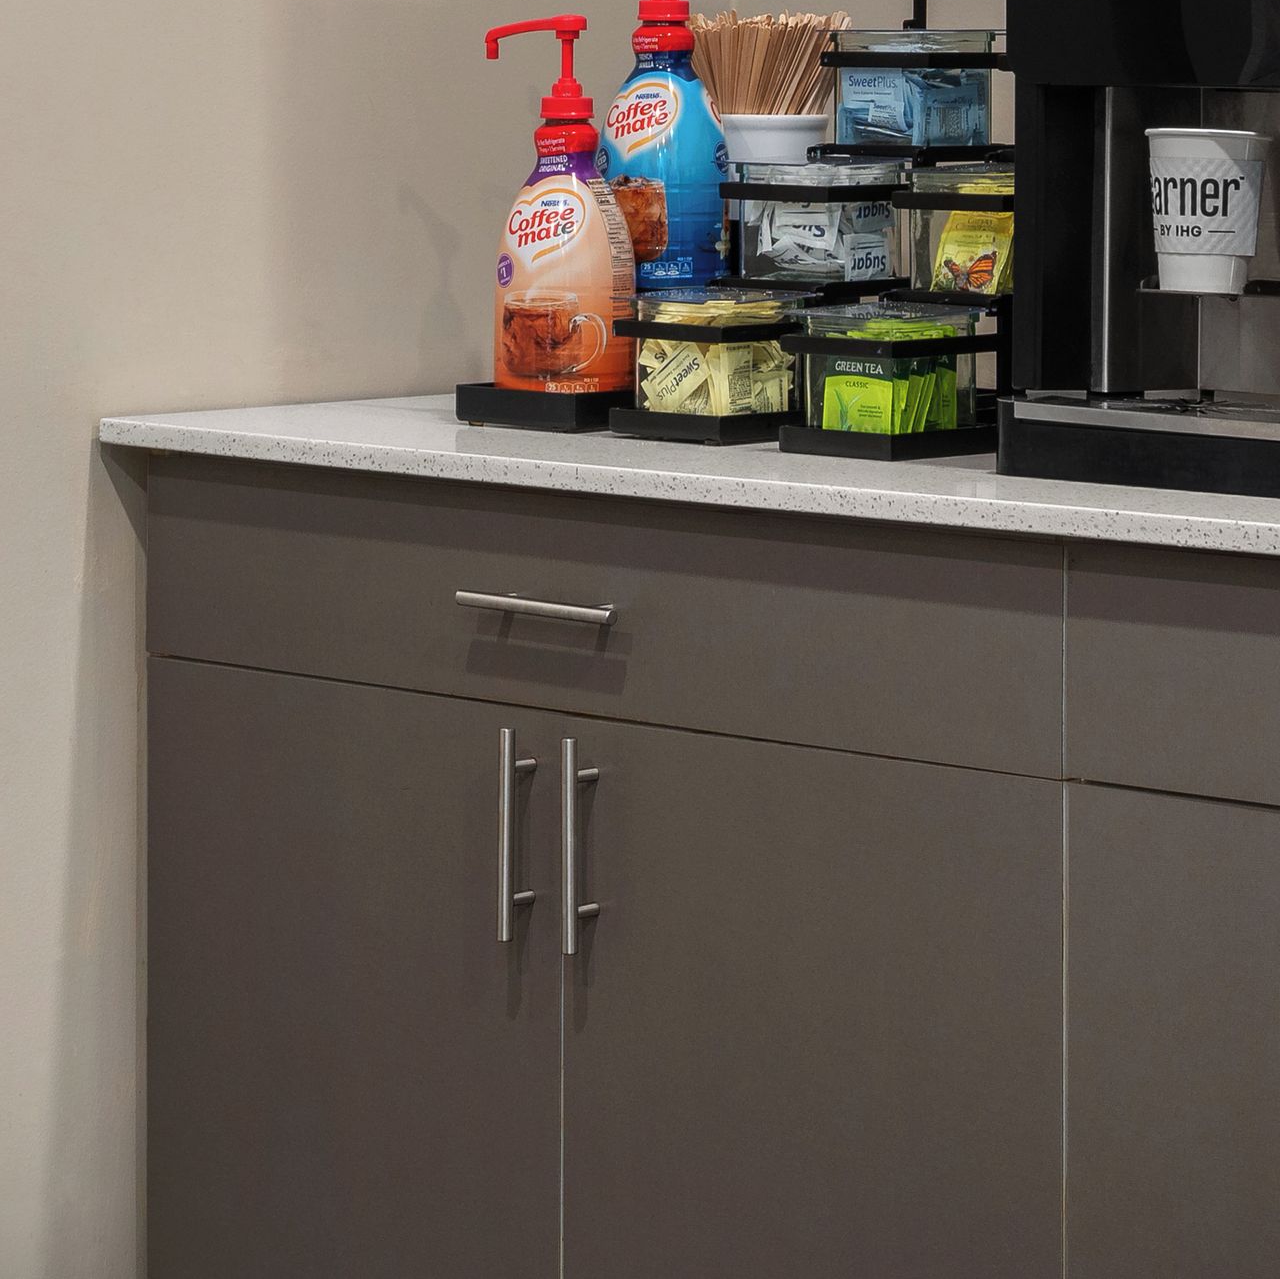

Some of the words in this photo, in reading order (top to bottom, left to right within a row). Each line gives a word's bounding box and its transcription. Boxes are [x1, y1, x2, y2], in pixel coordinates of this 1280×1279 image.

[606, 100, 667, 128] Coffee
[614, 112, 669, 140] mate
[508, 207, 575, 236] Coffee
[1160, 225, 1174, 237] BY
[1175, 225, 1202, 237] IHG
[518, 220, 575, 248] mate
[851, 251, 887, 271] Sugar
[835, 360, 864, 373] GREEN
[864, 363, 884, 375] TEA
[845, 380, 869, 389] CLASSIC
